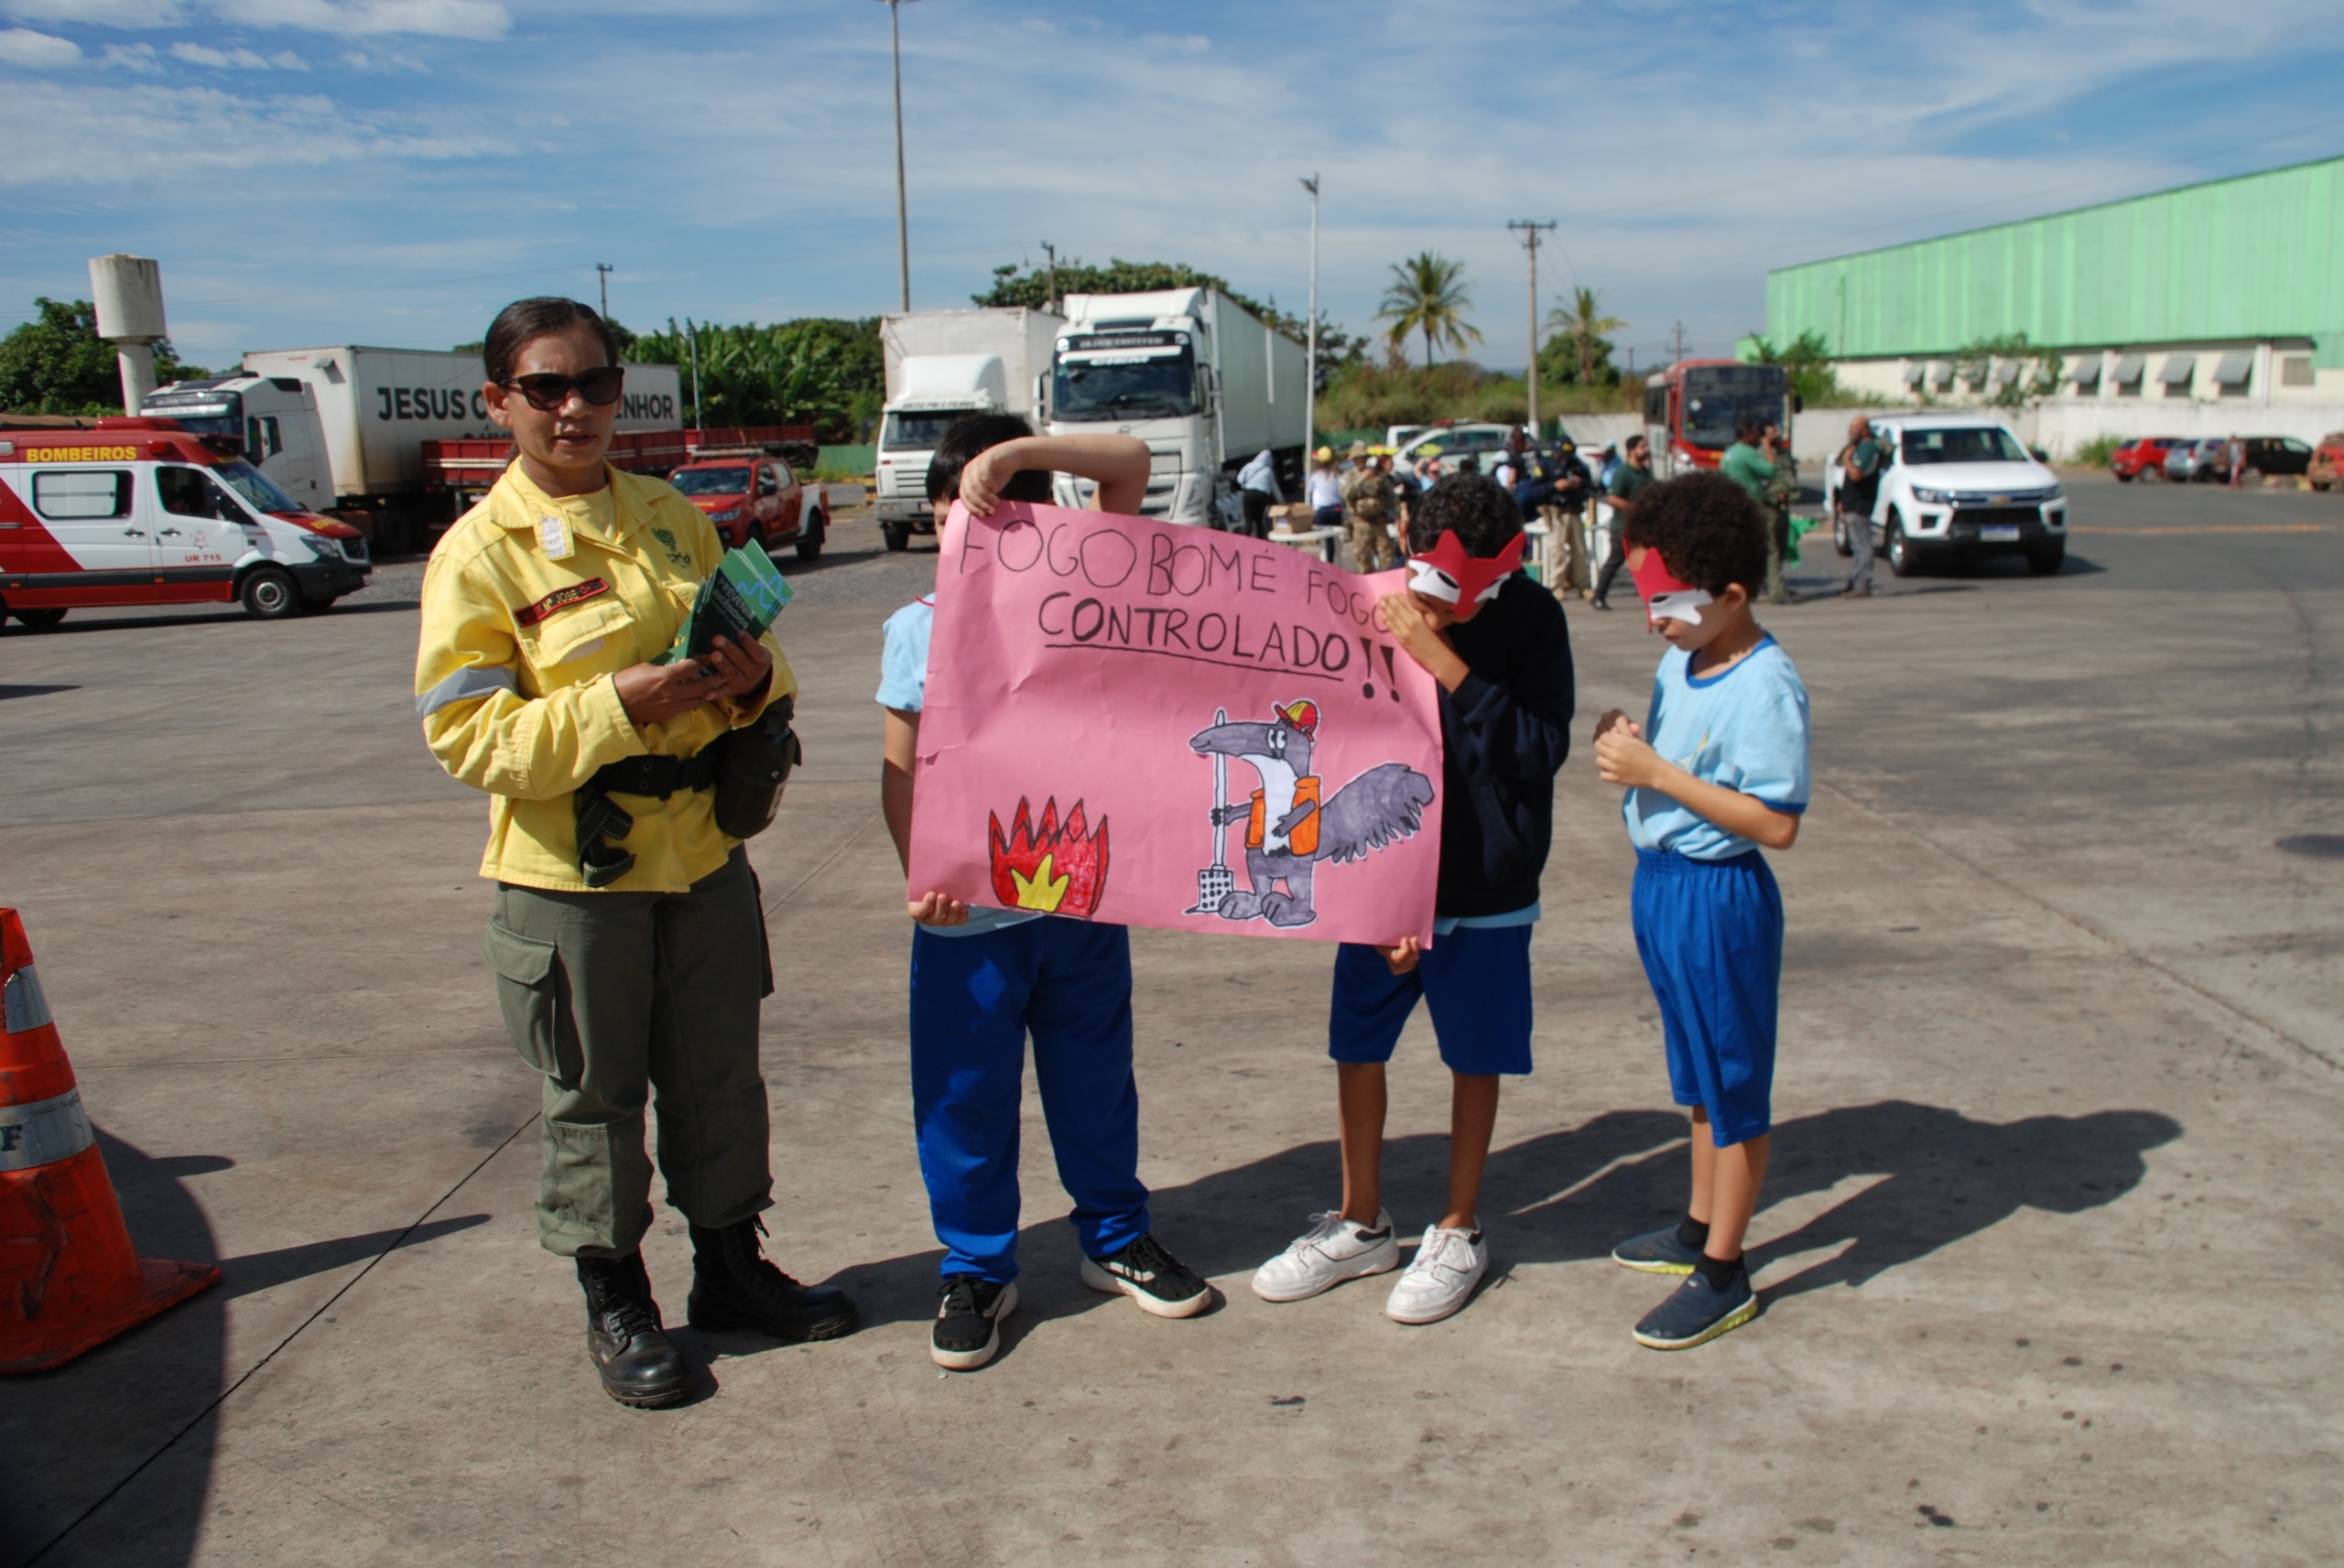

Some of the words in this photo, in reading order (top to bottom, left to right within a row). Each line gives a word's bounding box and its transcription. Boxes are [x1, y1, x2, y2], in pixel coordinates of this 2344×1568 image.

[377, 387, 466, 420] JESUS
[615, 394, 674, 419] NHOR
[27, 446, 137, 462] BOMBEIROS
[185, 555, 200, 563] UR
[203, 554, 222, 562] 715
[717, 578, 756, 622] PREVENIR
